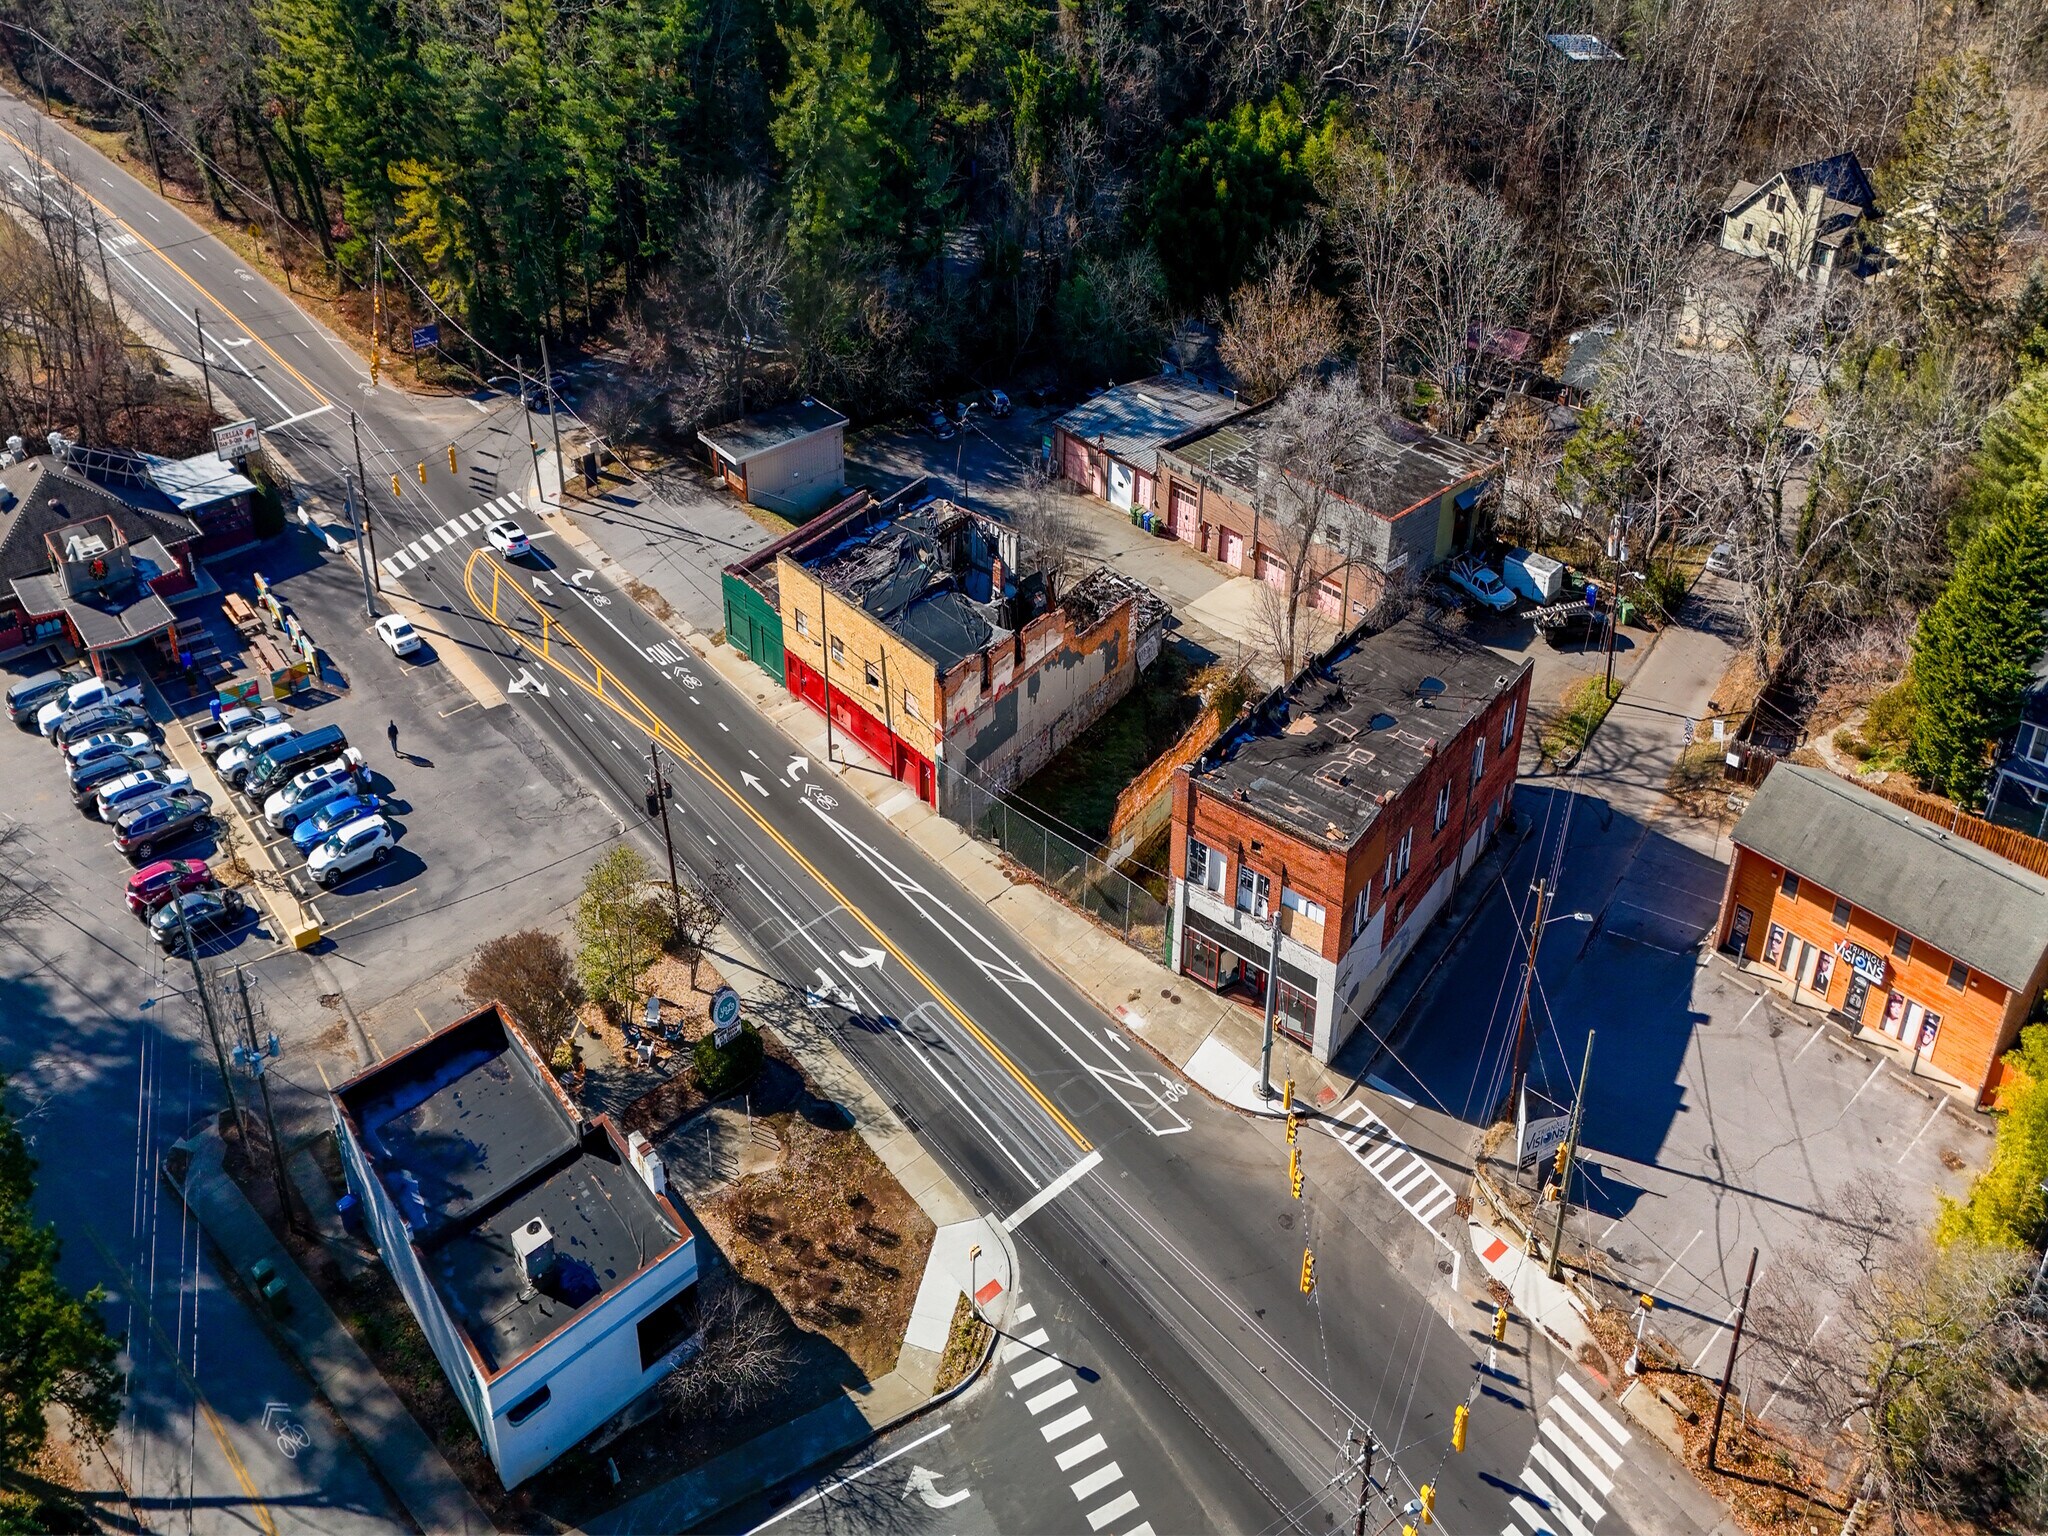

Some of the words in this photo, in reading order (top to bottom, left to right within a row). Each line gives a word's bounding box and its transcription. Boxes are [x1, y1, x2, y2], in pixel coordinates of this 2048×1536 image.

[645, 638, 691, 666] ONLY
[1833, 939, 1885, 980] VISIONS
[1848, 943, 1887, 969] TRIANGLE
[1526, 1126, 1566, 1151] VISIONS
